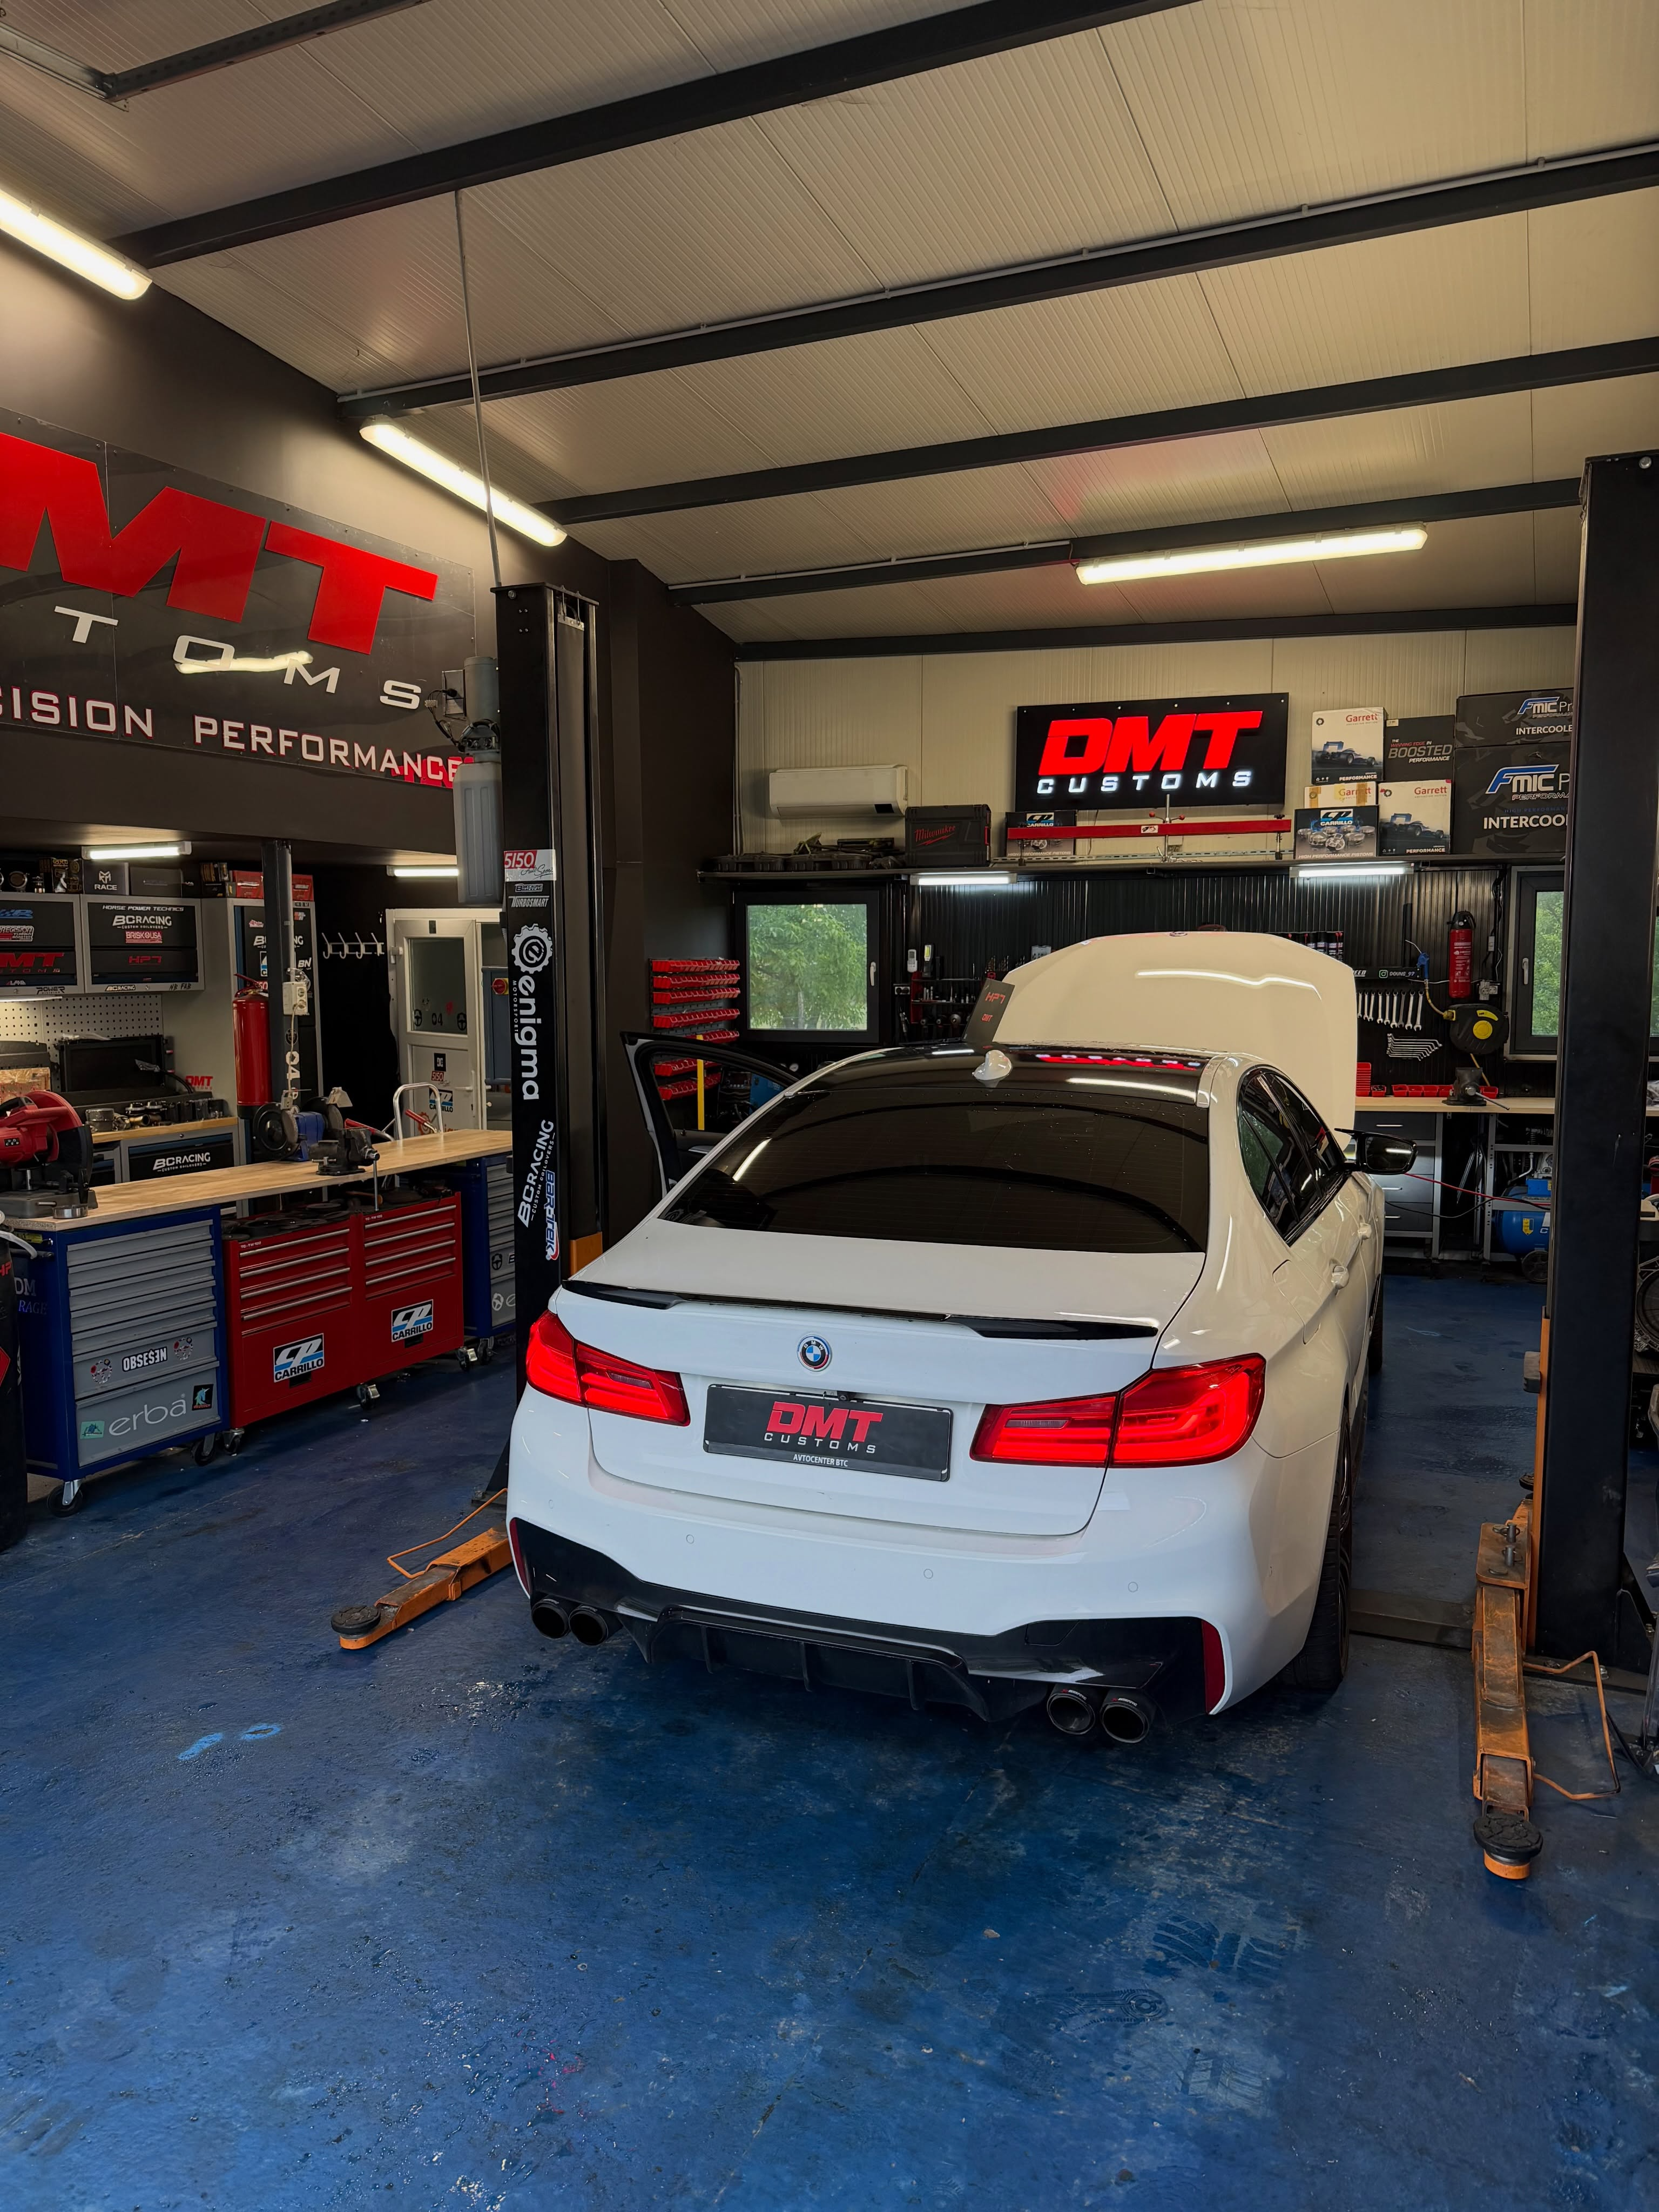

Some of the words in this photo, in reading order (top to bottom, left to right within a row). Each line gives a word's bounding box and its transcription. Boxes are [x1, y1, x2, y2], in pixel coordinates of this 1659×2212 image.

[1346, 713, 1378, 723] Garrett
[193, 714, 463, 783] PERFORMANCE
[1038, 711, 1263, 775] DMT
[1388, 745, 1453, 758] BOOSTED
[1037, 771, 1251, 794] CUSTOMS
[1414, 786, 1447, 795] Garrett
[1483, 814, 1568, 829] INTERCOO
[914, 825, 955, 842] Milwaukee
[504, 852, 534, 868] 5150
[508, 895, 550, 907] TURBOSMART
[36, 986, 65, 994] POWER
[432, 1013, 443, 1026] 04
[515, 975, 542, 1100] enigma
[432, 1073, 443, 1081] 5150
[531, 1184, 542, 1213] CUSTOM
[540, 1140, 554, 1182] COILOVERS
[393, 1323, 432, 1341] CARRILLO
[804, 1340, 824, 1350] BMW
[275, 1358, 323, 1381] CARRILLO
[767, 1401, 883, 1442] DMT
[764, 1432, 876, 1453] CUSTOMS
[793, 1454, 834, 1465] AVTOCENTER
[835, 1459, 848, 1467] BTC
